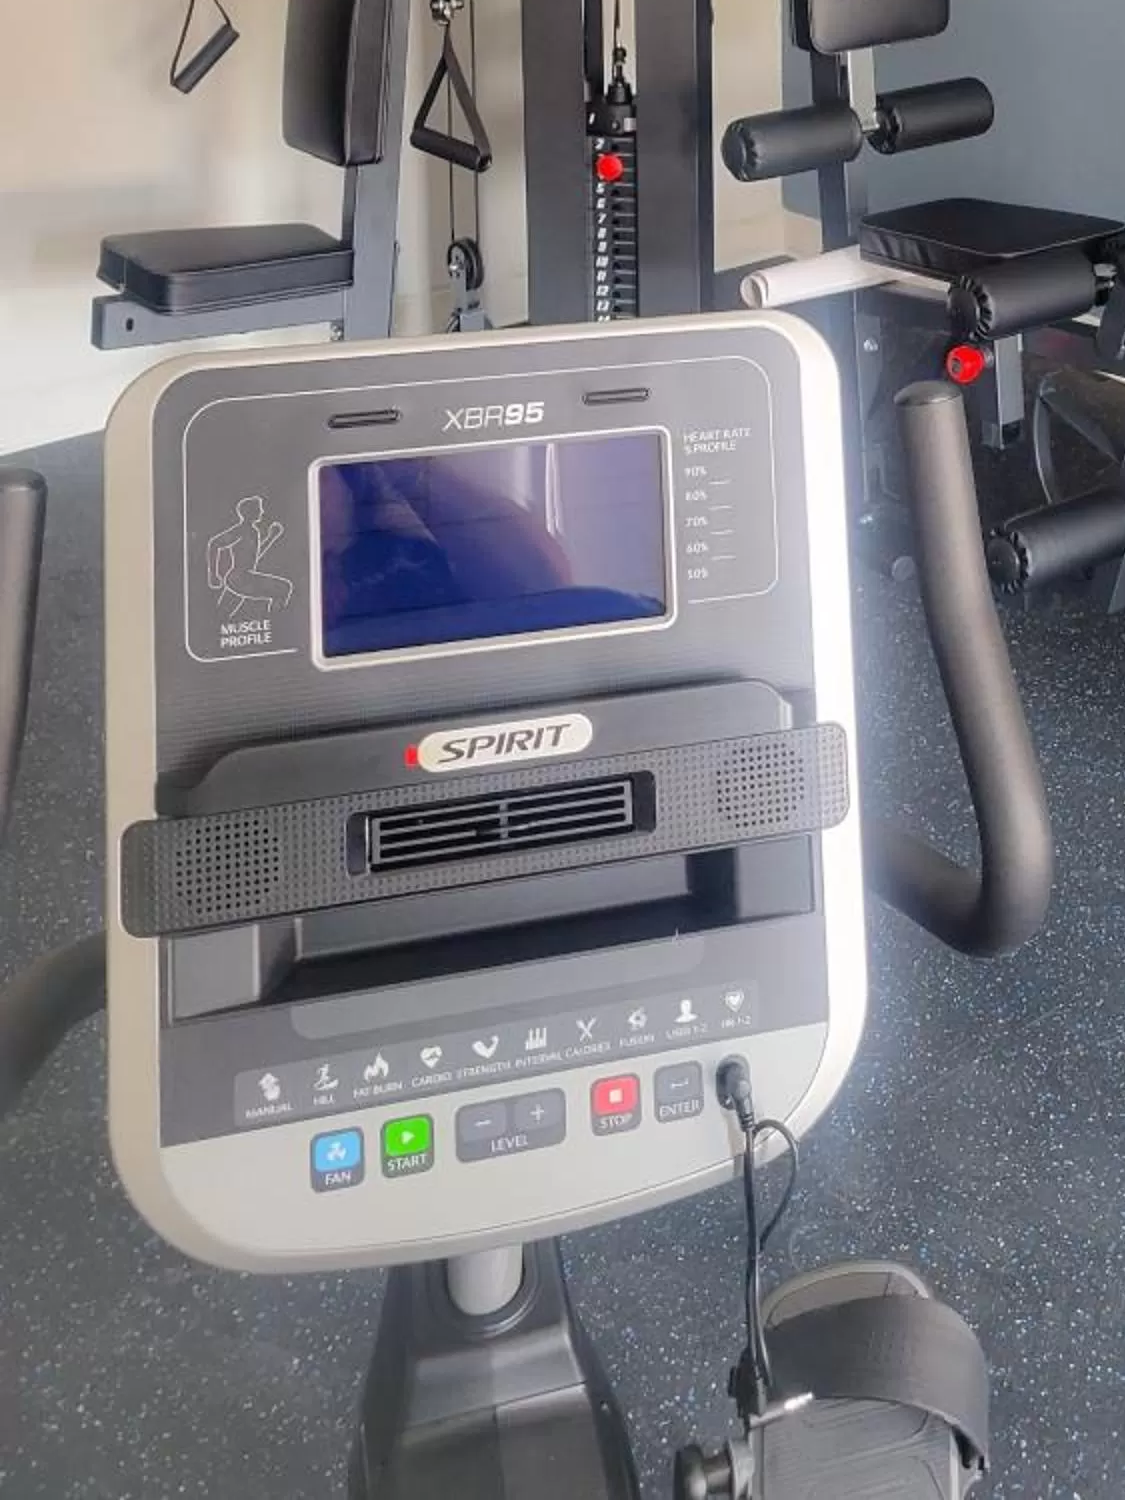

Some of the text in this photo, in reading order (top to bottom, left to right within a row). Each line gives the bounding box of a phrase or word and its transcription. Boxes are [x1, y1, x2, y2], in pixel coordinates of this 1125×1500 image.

[442, 401, 545, 432] XBR95
[693, 439, 737, 453] PROFILE
[220, 619, 271, 635] MUSCLE
[220, 632, 273, 648] PROFILE
[435, 723, 571, 764] SPIRIT
[565, 1041, 611, 1059] CALORIES
[515, 1051, 563, 1069] INTERVAL
[456, 1060, 511, 1080] STRENGTH
[411, 1071, 453, 1088] CARDIO
[353, 1081, 403, 1099] FAT BURN
[245, 1102, 294, 1119] MANUAL
[659, 1100, 700, 1117] ENTER
[599, 1113, 632, 1130] STOP
[491, 1133, 528, 1152] LEVEL
[387, 1154, 427, 1172] START
[325, 1171, 351, 1186] FAN
